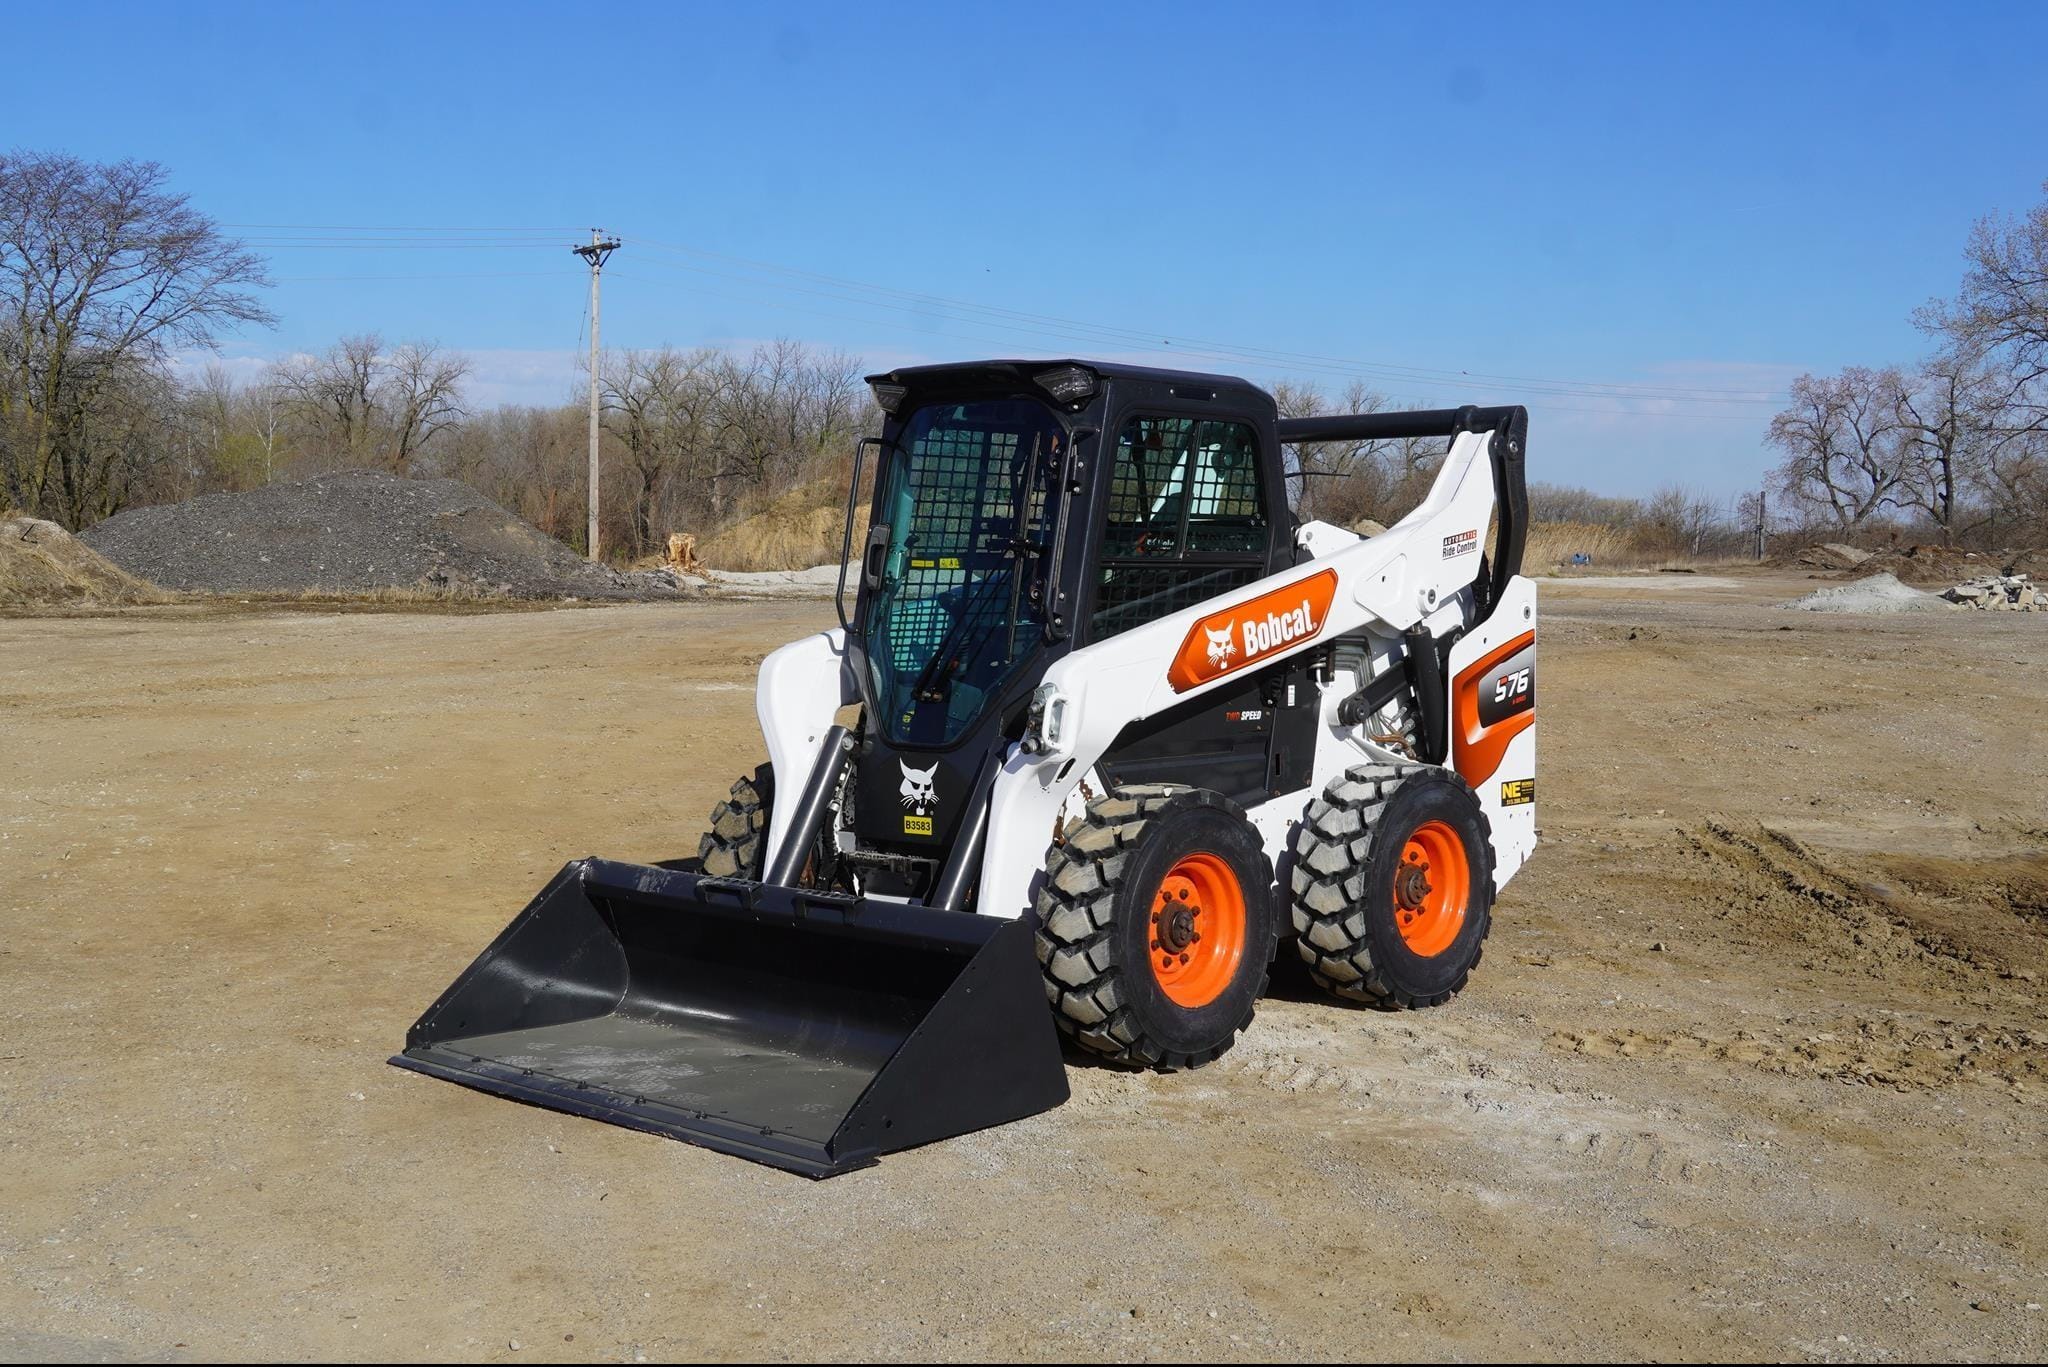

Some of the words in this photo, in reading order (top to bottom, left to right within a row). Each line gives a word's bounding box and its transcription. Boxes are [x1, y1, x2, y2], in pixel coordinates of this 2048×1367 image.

[1444, 531, 1477, 546] AUTOMATIC
[1443, 546, 1456, 557] Ride
[1457, 540, 1477, 554] Control
[1243, 600, 1313, 657] Bobcat
[1494, 667, 1529, 703] S76
[1241, 710, 1262, 721] SPEED
[1502, 781, 1521, 799] NE
[905, 820, 931, 831] B3583
